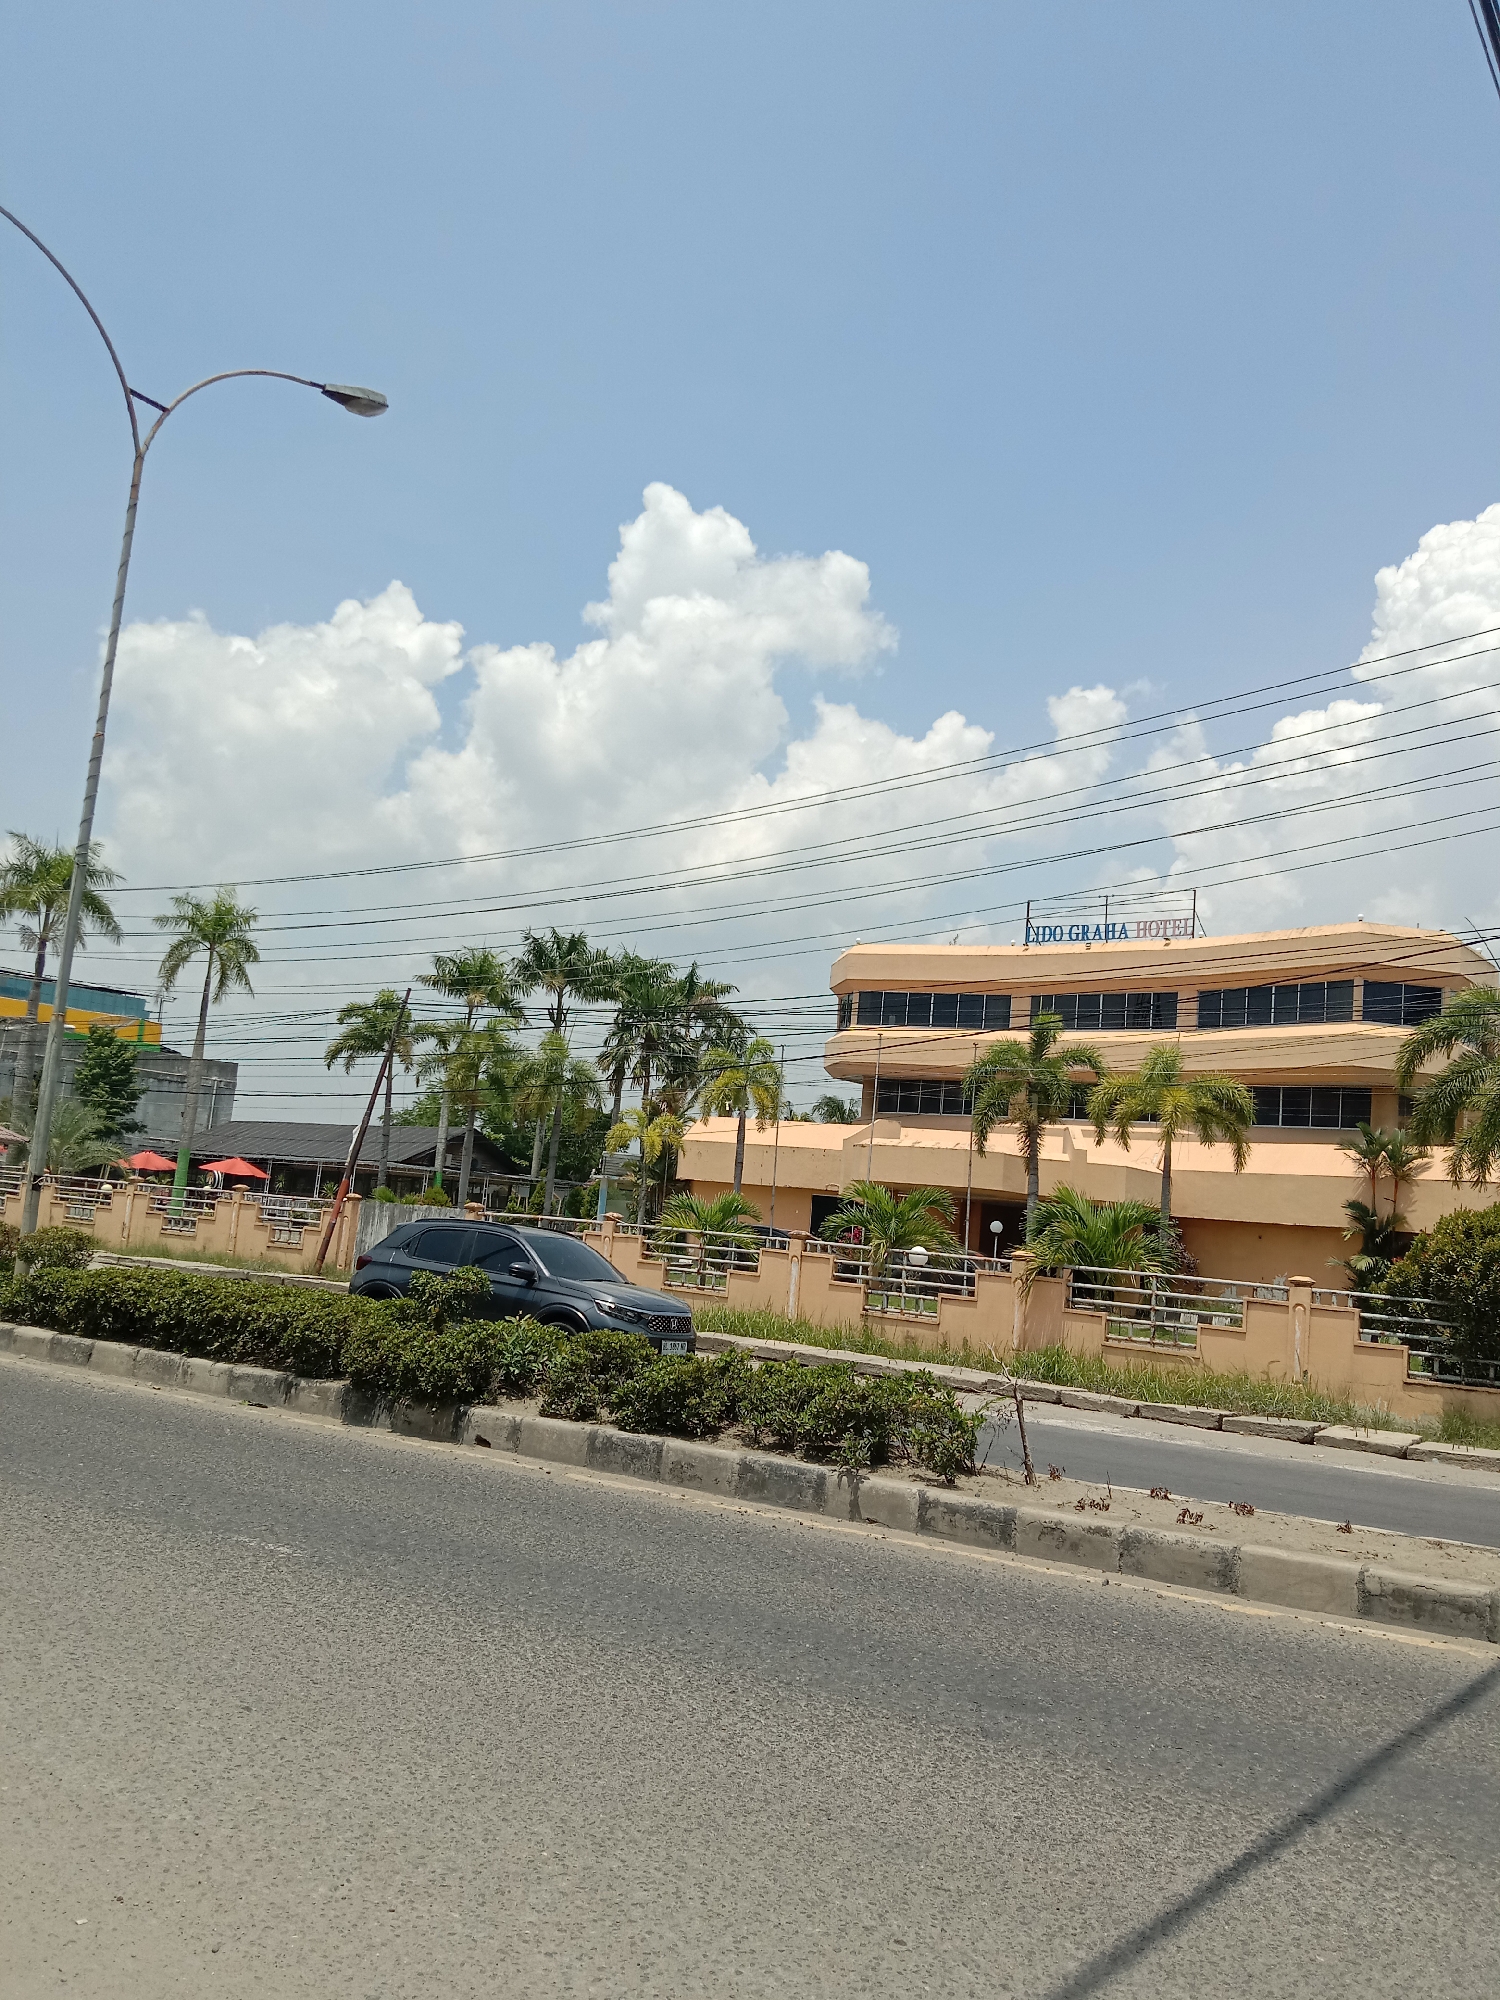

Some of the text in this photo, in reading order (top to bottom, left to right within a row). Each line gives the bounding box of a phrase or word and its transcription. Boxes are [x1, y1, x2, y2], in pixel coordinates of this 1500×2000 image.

[1026, 918, 1193, 944] LIDO GRAHA HOTEL
